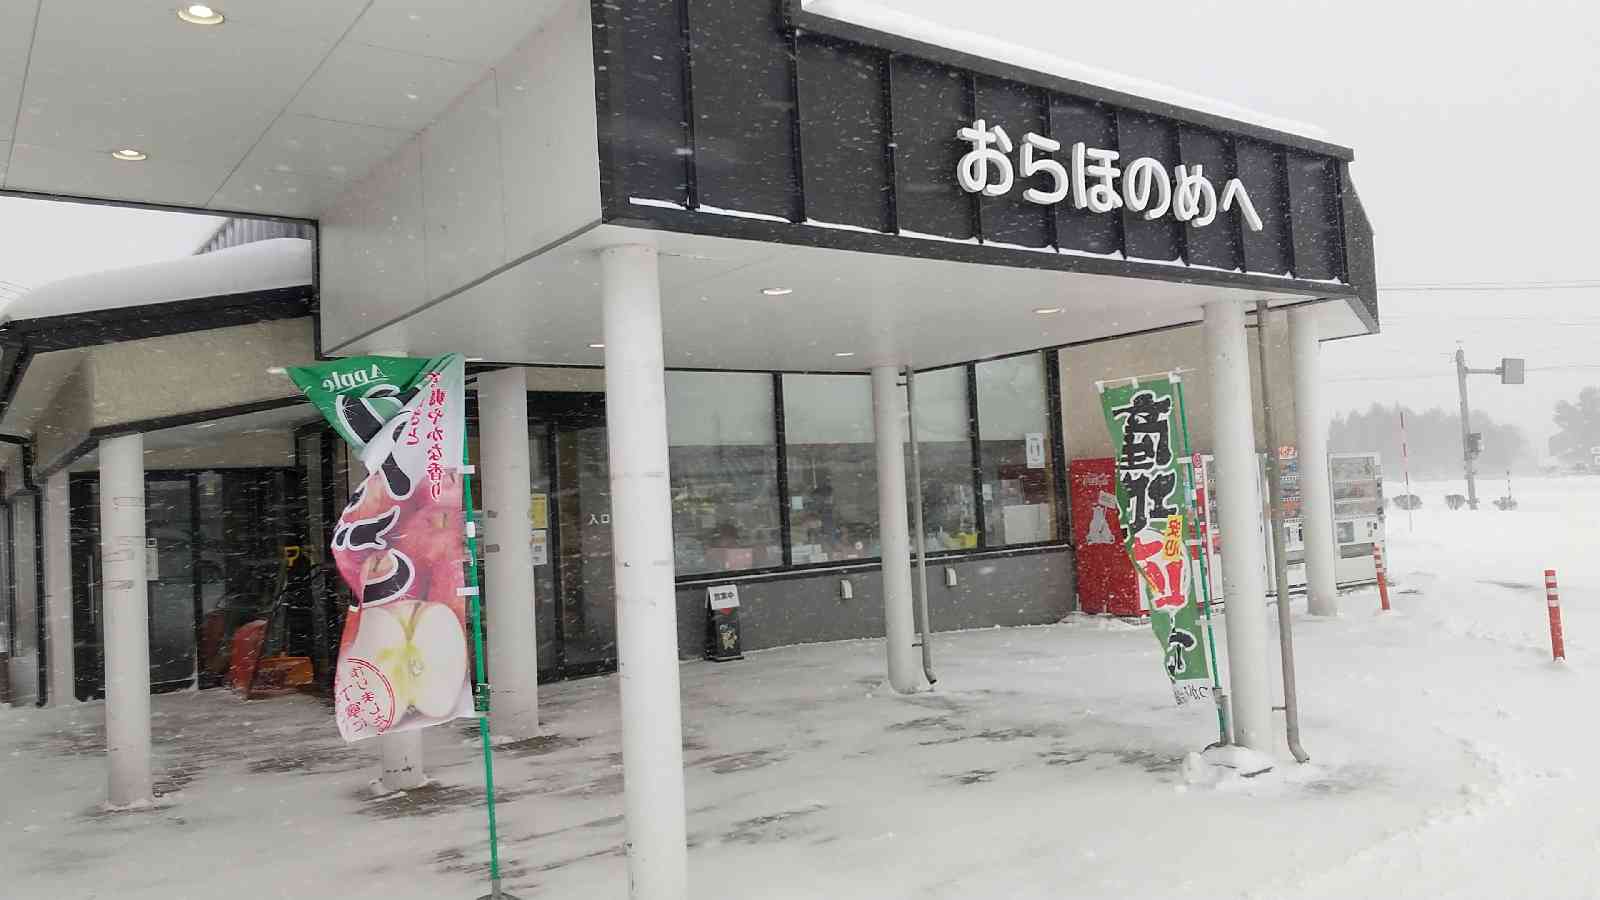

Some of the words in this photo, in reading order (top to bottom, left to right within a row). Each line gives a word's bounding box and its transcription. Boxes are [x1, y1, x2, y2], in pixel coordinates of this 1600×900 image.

[957, 119, 1263, 232] おらほのめへ
[588, 513, 610, 527] 入口
